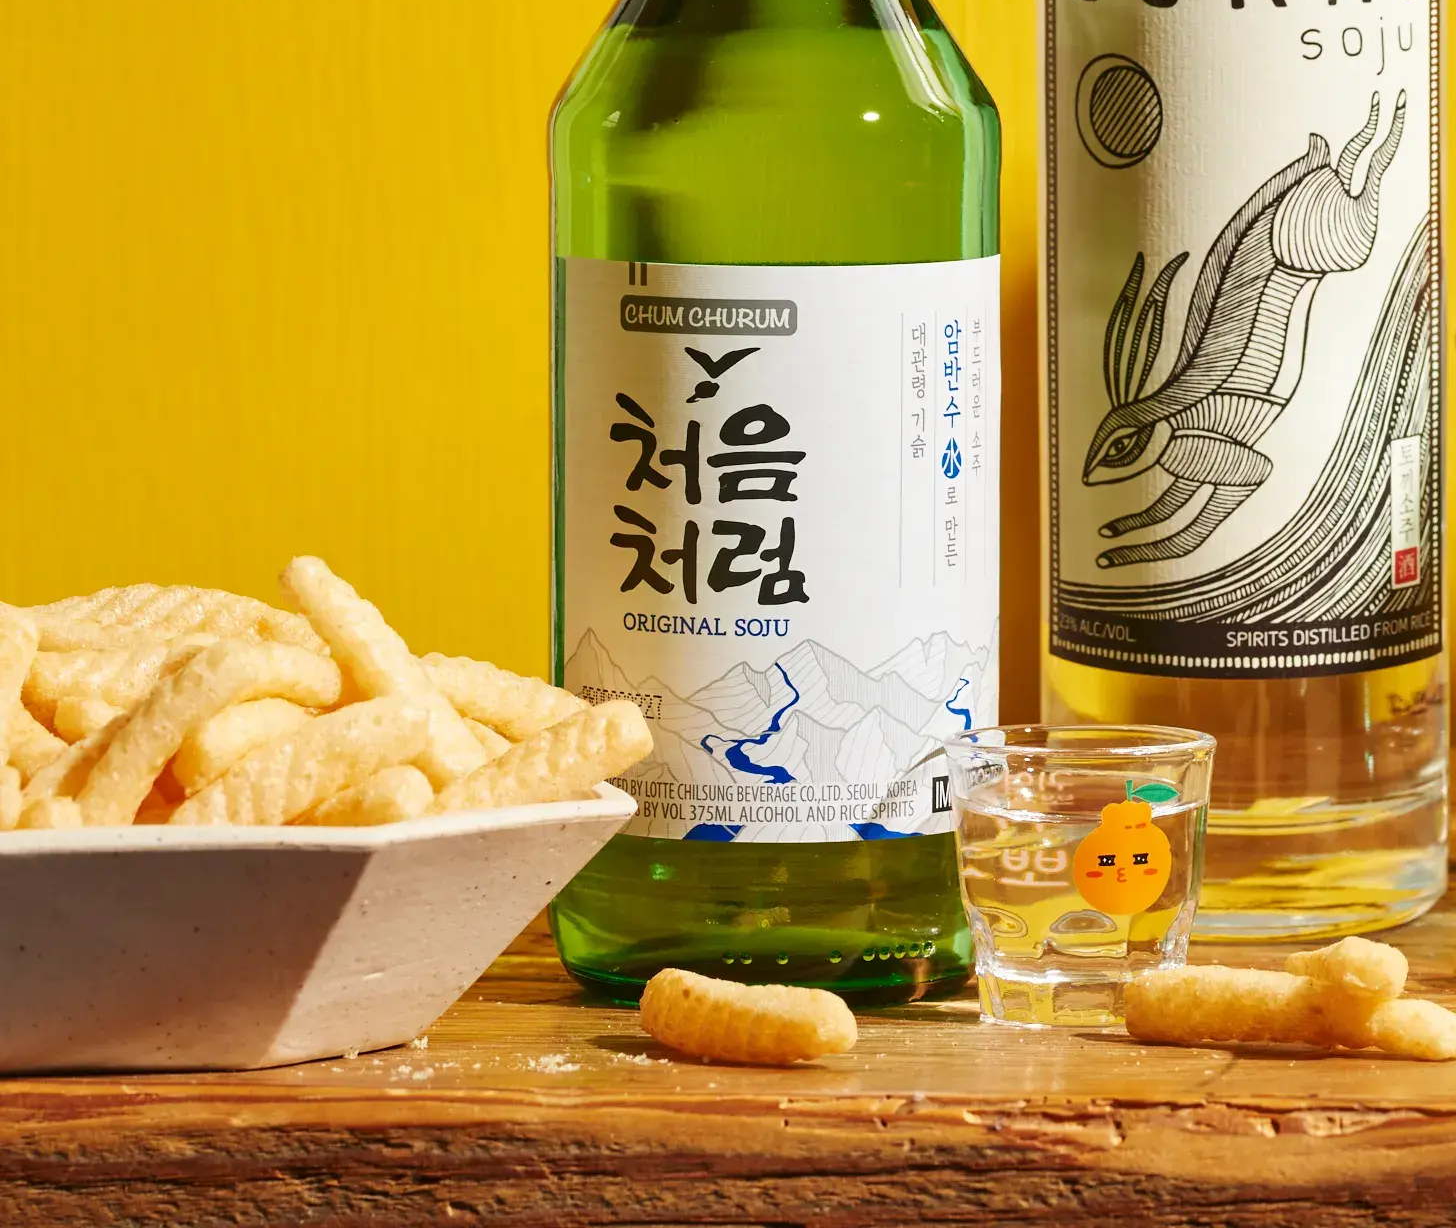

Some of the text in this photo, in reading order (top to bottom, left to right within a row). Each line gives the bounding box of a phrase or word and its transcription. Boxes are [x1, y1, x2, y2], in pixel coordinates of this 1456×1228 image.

[1300, 16, 1414, 76] soju
[625, 304, 790, 328] CHUM CHURUM
[911, 322, 927, 458] 대관령 기슭
[610, 392, 806, 504] 처음
[610, 505, 810, 605] 처럼
[945, 516, 958, 567] 만든
[623, 613, 790, 637] ORIGINAL SOJU
[1226, 610, 1432, 648] SPIRITS DISTILLED FROM RICE
[631, 779, 643, 797] BY
[646, 782, 674, 799] LOTTE
[677, 783, 733, 802] CHILSUNG
[737, 785, 796, 802] BEVERAGE
[847, 782, 883, 802] SEOUL,
[887, 779, 918, 798] KOREA
[644, 801, 659, 818] BY
[661, 803, 686, 820] VOL
[689, 805, 735, 822] 375ML
[739, 806, 802, 822] ALCOHOL
[806, 805, 836, 822] AND
[840, 803, 868, 821] RICE
[871, 800, 915, 820] SPIRITS
